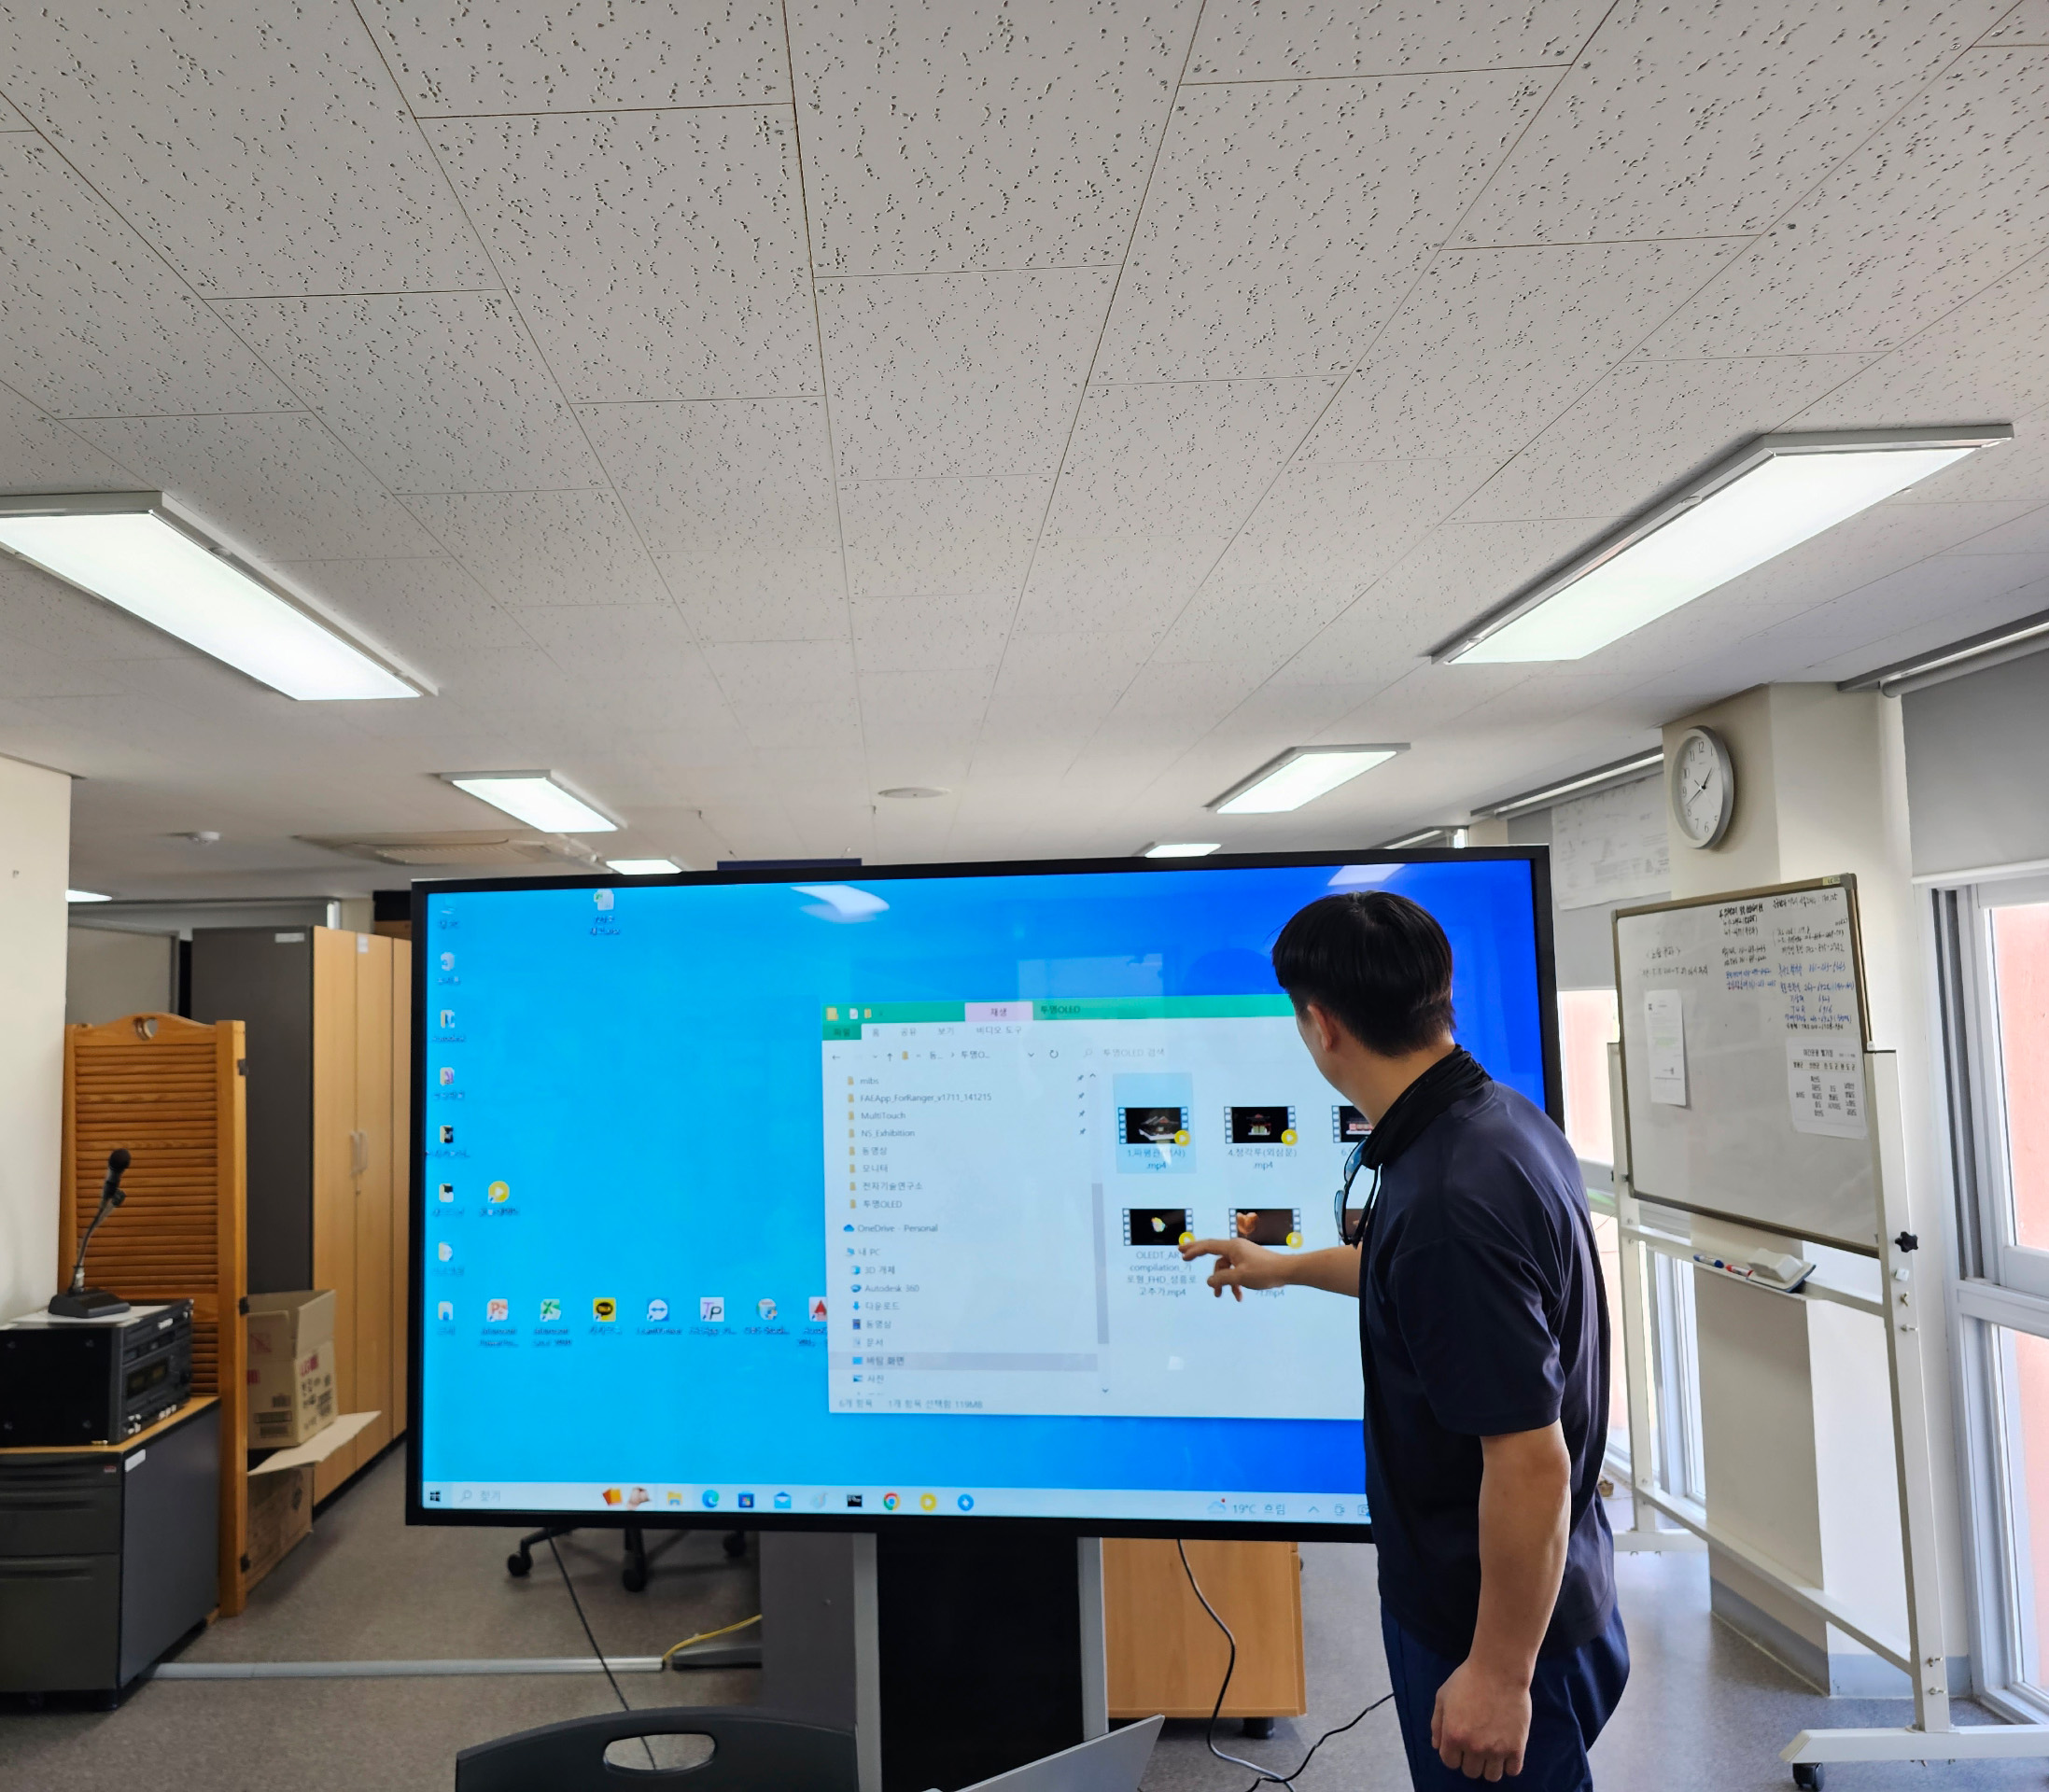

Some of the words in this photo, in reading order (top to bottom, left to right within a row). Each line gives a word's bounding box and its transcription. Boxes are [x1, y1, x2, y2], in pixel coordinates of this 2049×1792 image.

[1699, 741, 1705, 753] 12
[1690, 749, 1695, 762] 11
[990, 1007, 1007, 1017] 재생
[1040, 1004, 1081, 1015] 투명OLED
[937, 1027, 955, 1036] 보기
[975, 1026, 1002, 1035] 비디오
[1005, 1026, 1022, 1035] 도구
[861, 1110, 906, 1120] MultiTouch
[861, 1128, 915, 1139] NS_Exhibition
[863, 1146, 888, 1156] 동영상
[1254, 1160, 1273, 1170] .mp4
[863, 1199, 903, 1209] 투명OLED
[857, 1224, 895, 1233] OneDrive
[904, 1224, 938, 1233] Personal
[869, 1248, 880, 1257] PC
[864, 1283, 903, 1293] Autodesk
[905, 1283, 919, 1293] 360
[864, 1301, 900, 1310] 다운로드
[866, 1320, 891, 1329] 동영상
